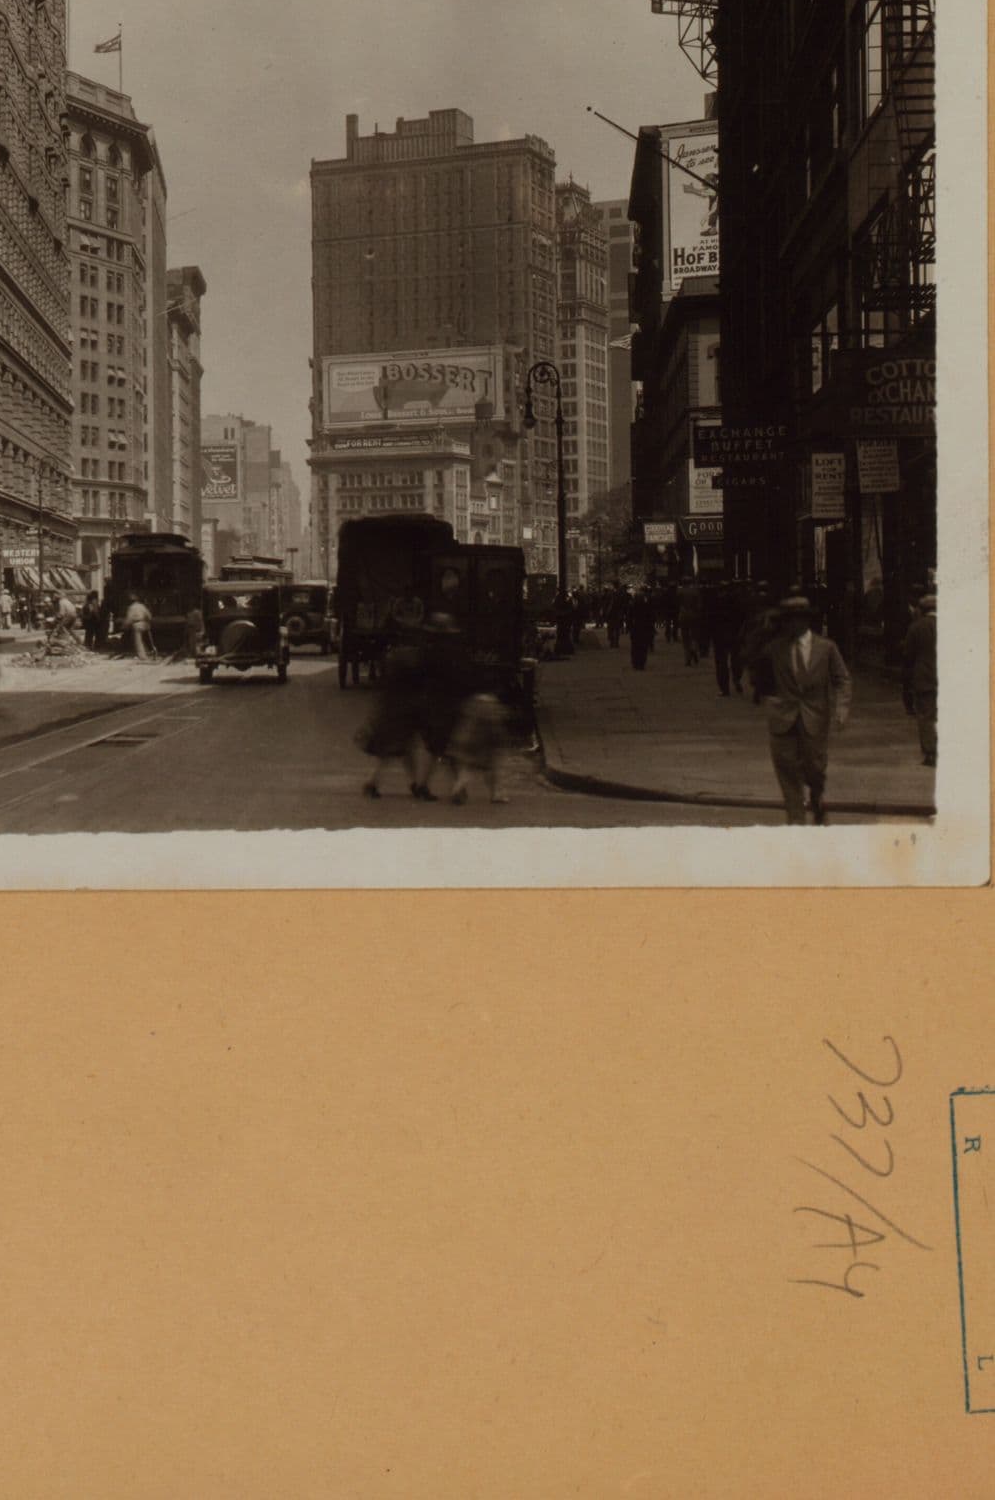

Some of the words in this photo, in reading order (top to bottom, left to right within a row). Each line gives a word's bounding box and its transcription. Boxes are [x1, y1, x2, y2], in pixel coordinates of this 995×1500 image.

[673, 247, 718, 266] HOFB
[673, 265, 717, 275] BROADWAY
[386, 363, 492, 397] BOSSERT
[865, 359, 934, 385] COTTO
[868, 379, 934, 404] EXCHAN
[849, 405, 934, 425] RESTAUR
[698, 426, 788, 439] EXCHANGE
[716, 476, 766, 485] CIGARS
[963, 1135, 982, 1154] R
[977, 1355, 994, 1371] L
